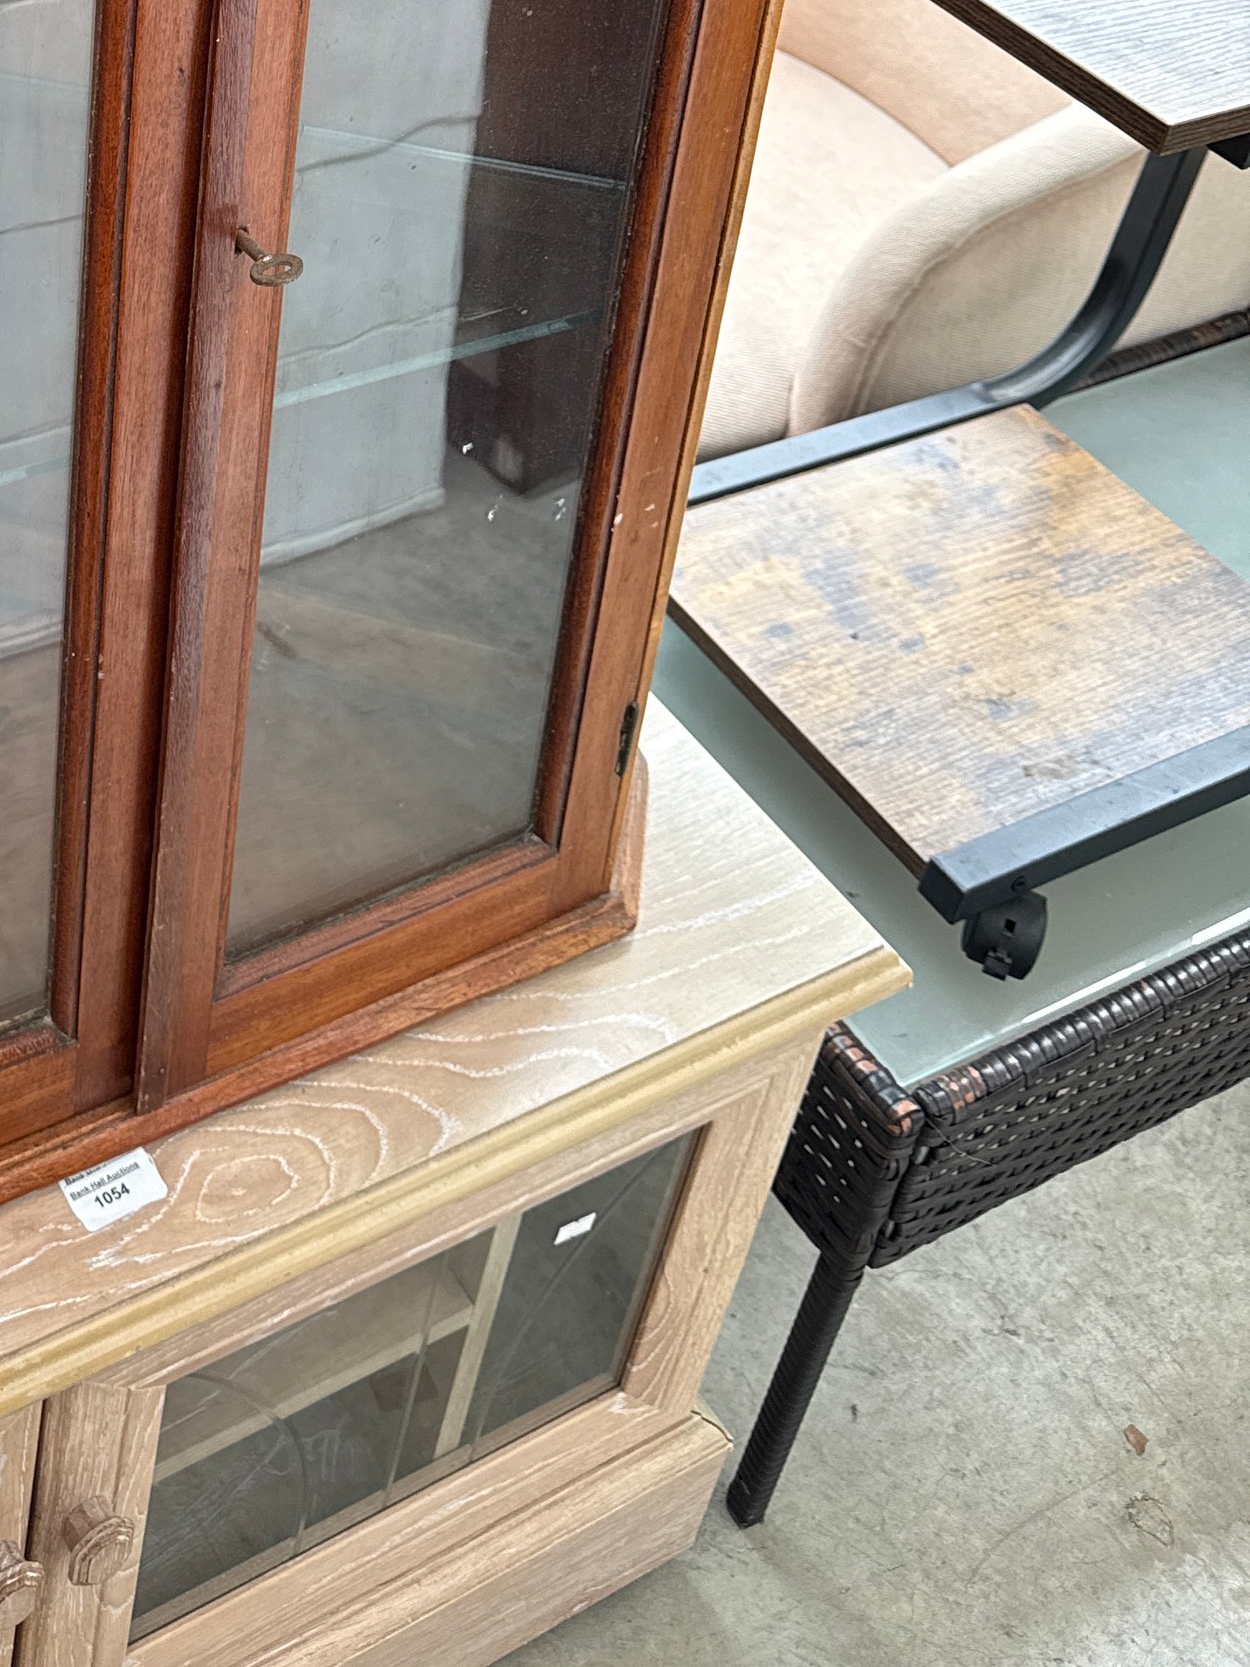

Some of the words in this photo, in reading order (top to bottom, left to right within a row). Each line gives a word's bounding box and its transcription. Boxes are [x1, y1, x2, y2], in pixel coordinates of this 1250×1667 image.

[70, 1185, 90, 1201] Bank
[90, 1177, 106, 1192] Hall
[106, 1162, 140, 1181] Auctions
[94, 1182, 130, 1208] 1054
